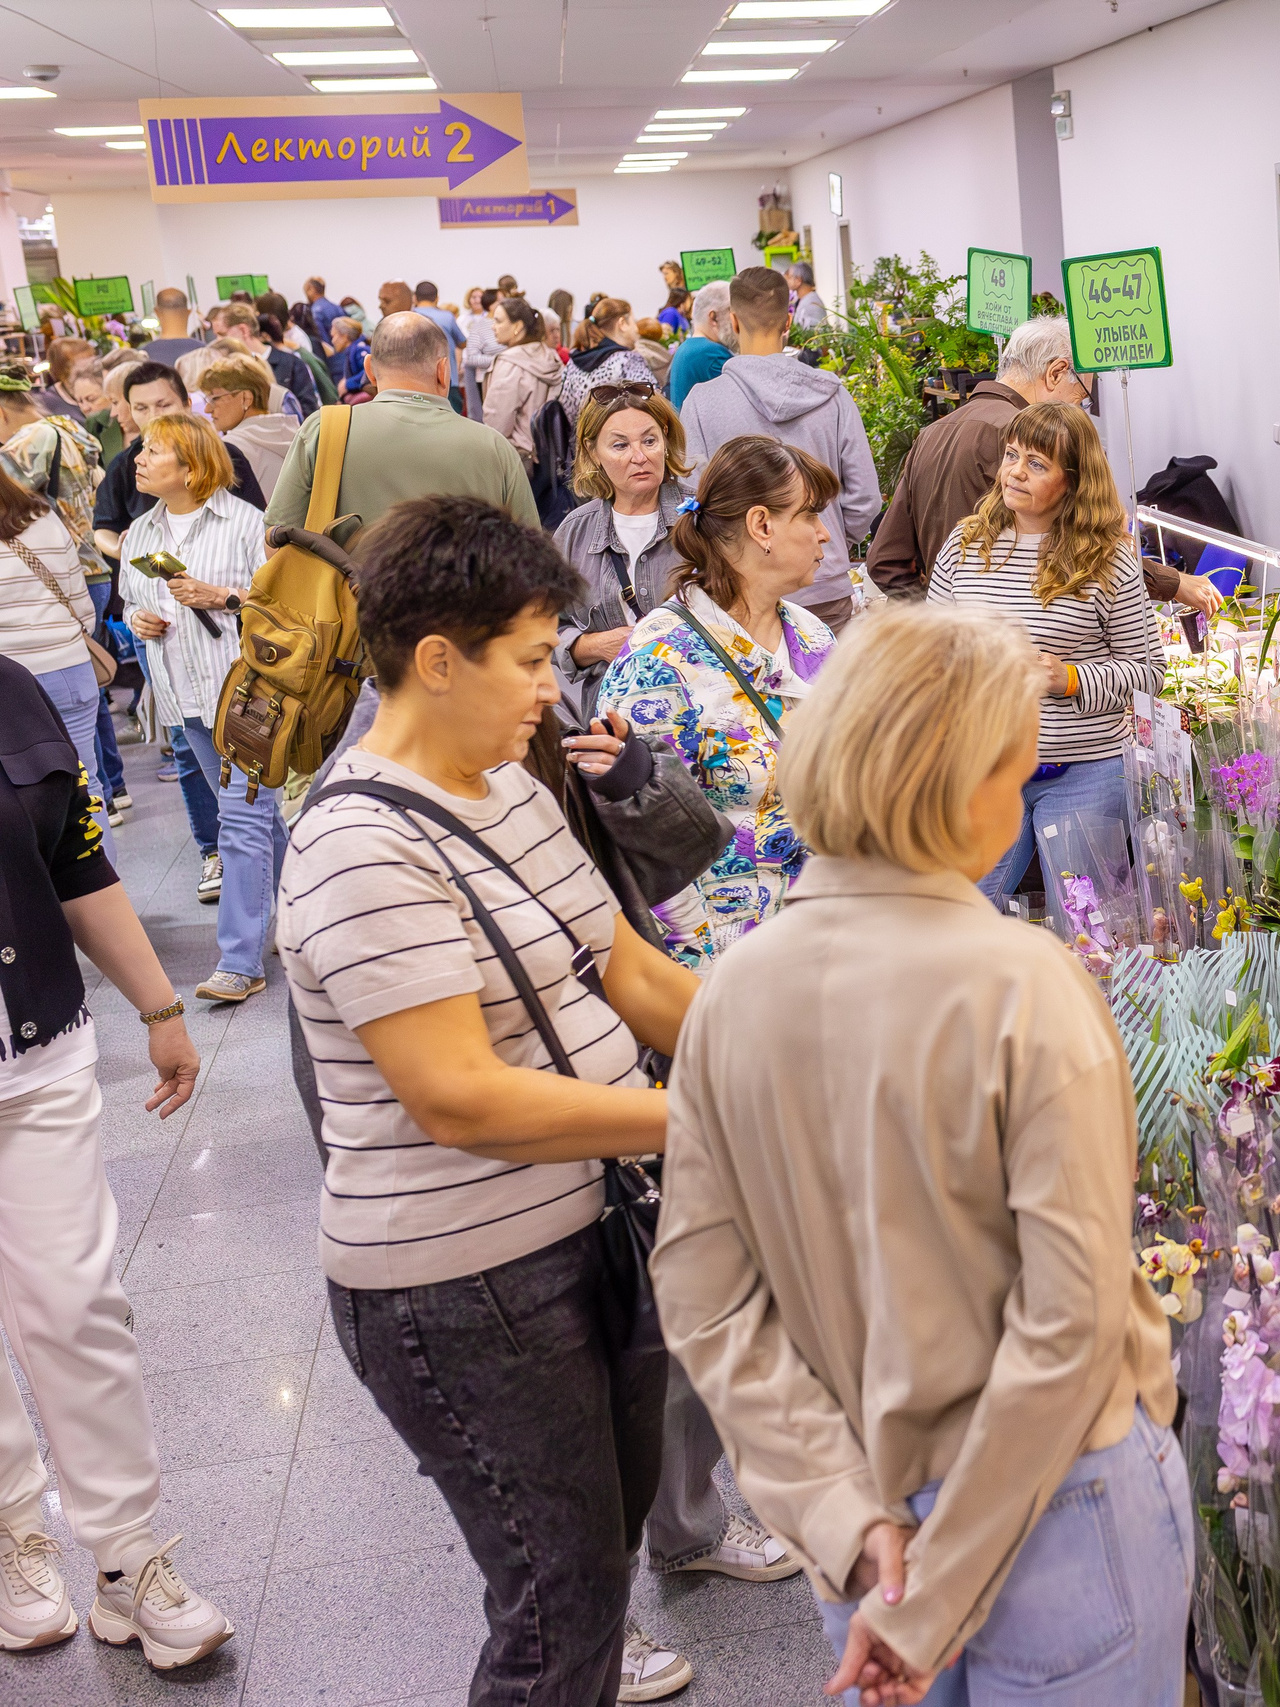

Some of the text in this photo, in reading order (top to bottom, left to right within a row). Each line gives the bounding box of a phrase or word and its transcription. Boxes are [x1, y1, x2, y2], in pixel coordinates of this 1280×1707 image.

[216, 121, 475, 172] Лекторий 2
[991, 268, 1006, 288] 48
[1088, 273, 1142, 304] 46-47
[977, 310, 1013, 324] ВЯЧЕСЛАВА
[1003, 305, 1012, 314] ОТ
[1095, 323, 1148, 344] УЛЫБКА
[1094, 343, 1154, 363] ОРХИДЕИ
